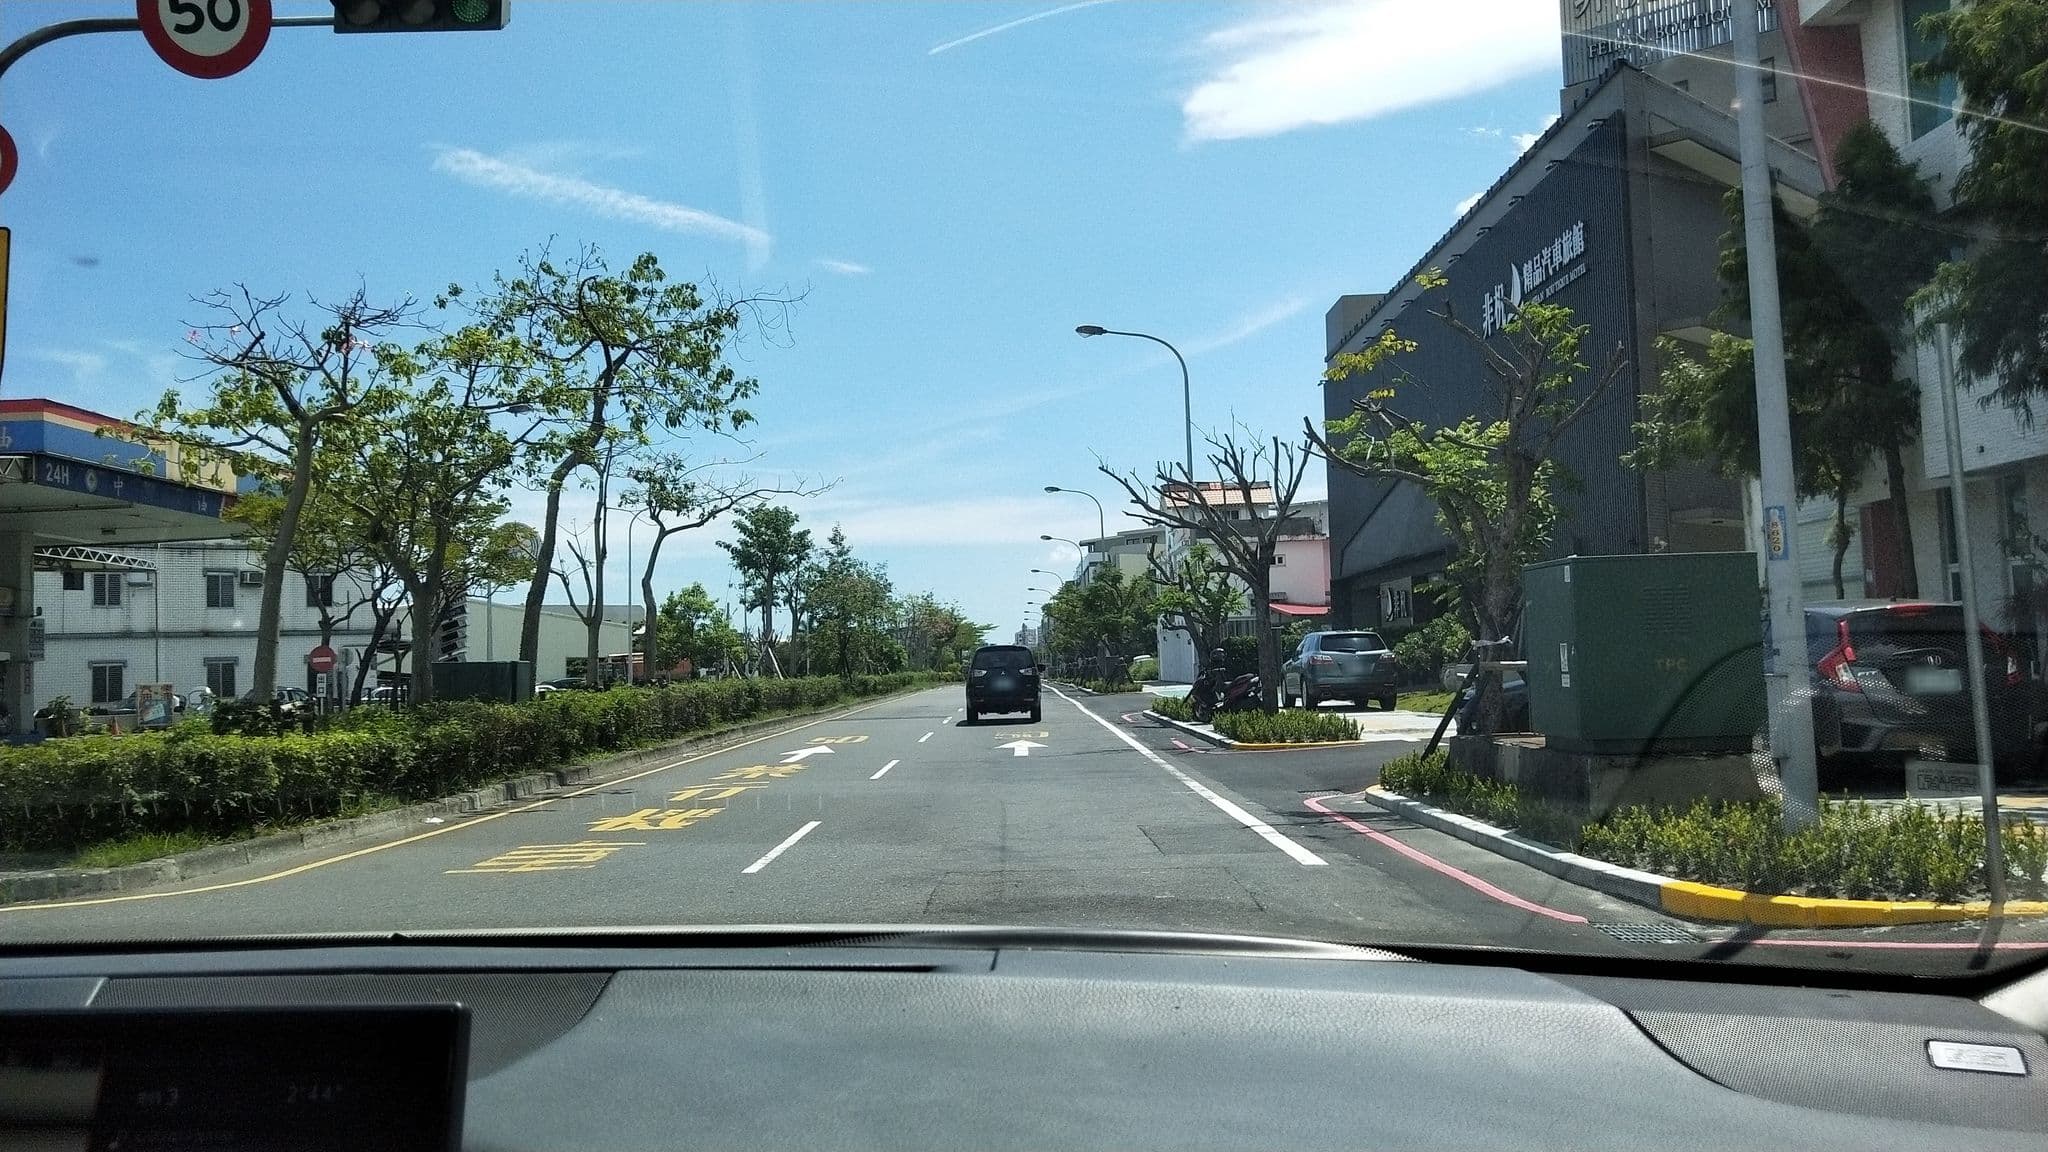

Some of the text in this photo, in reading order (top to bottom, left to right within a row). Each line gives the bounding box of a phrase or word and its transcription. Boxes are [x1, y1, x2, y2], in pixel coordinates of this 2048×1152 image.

[167, 0, 242, 36] 50
[1522, 220, 1585, 294] 精品汽車旅館
[45, 462, 70, 486] 24H
[113, 475, 124, 497] 中
